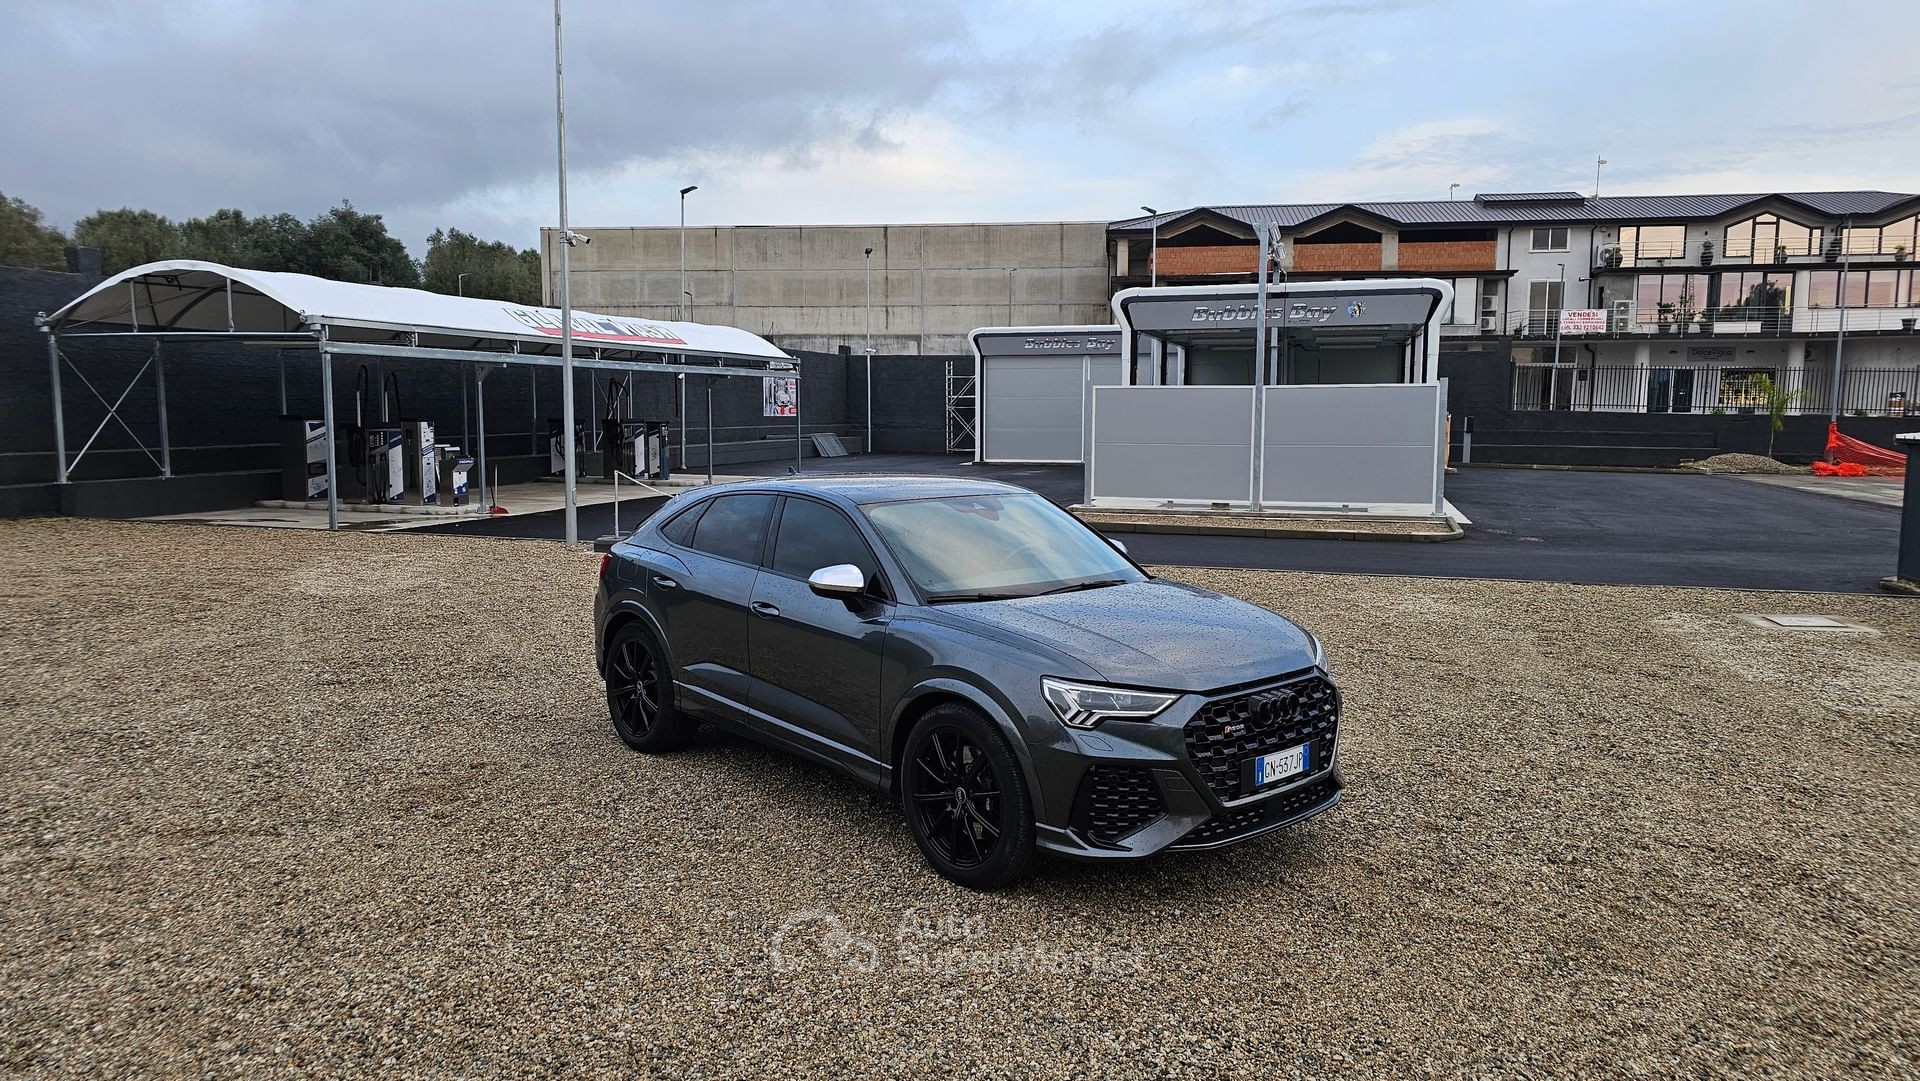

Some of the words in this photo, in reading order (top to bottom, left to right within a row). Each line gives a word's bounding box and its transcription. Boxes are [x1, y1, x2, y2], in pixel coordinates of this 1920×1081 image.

[1289, 302, 1337, 322] Bay
[1024, 337, 1081, 349] Bubbles
[1086, 336, 1116, 351] Bay
